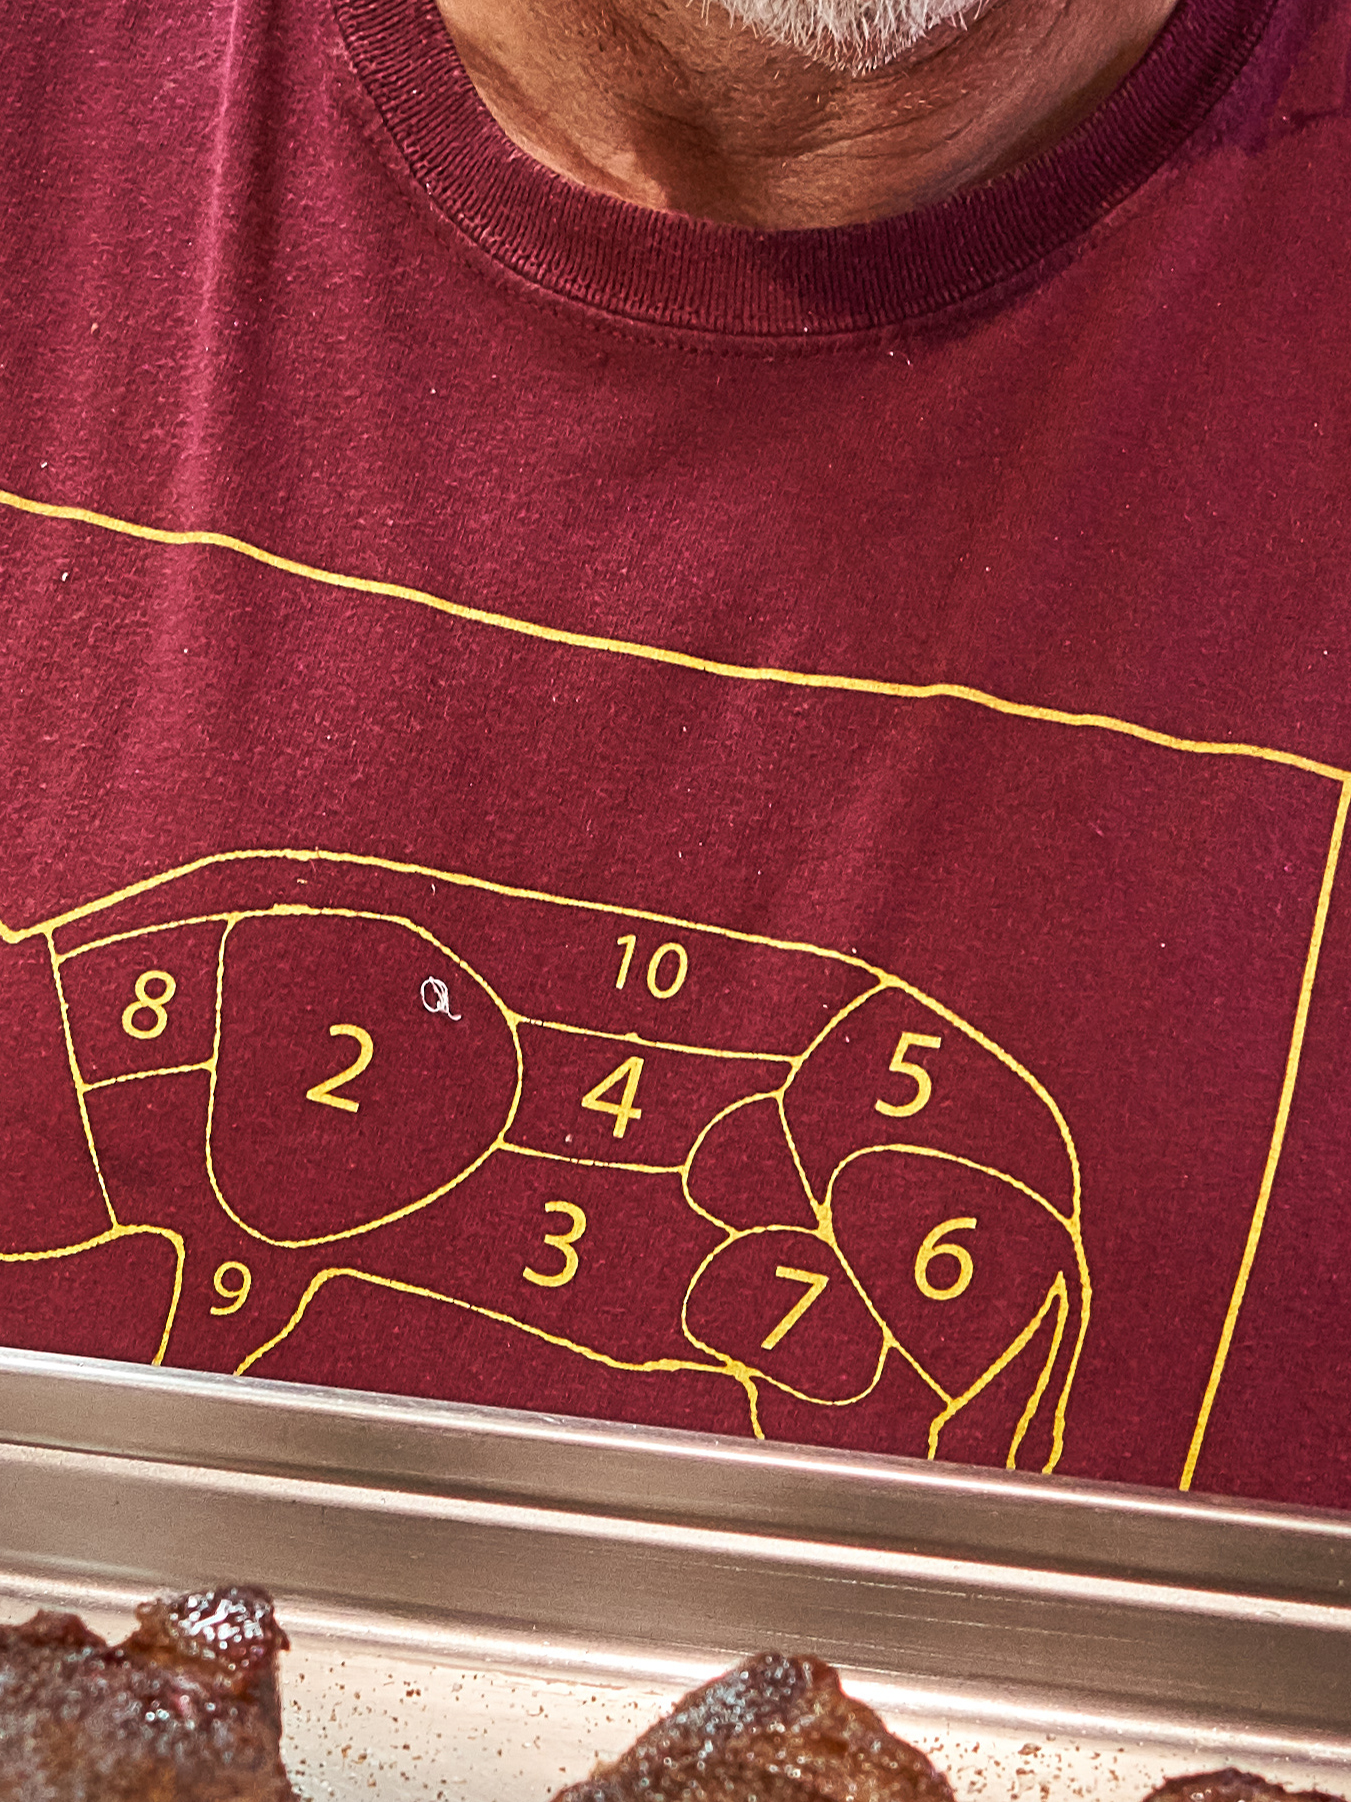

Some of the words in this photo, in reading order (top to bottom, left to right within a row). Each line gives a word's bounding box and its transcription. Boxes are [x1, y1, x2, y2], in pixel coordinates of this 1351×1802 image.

[121, 970, 177, 1040] 8
[616, 935, 688, 999] 10
[305, 1024, 374, 1113] 2
[581, 1056, 644, 1139] 4
[874, 1032, 942, 1118] 5
[522, 1200, 587, 1288] 3
[914, 1217, 978, 1301] 6
[209, 1260, 252, 1316] 9
[760, 1265, 830, 1351] 7
